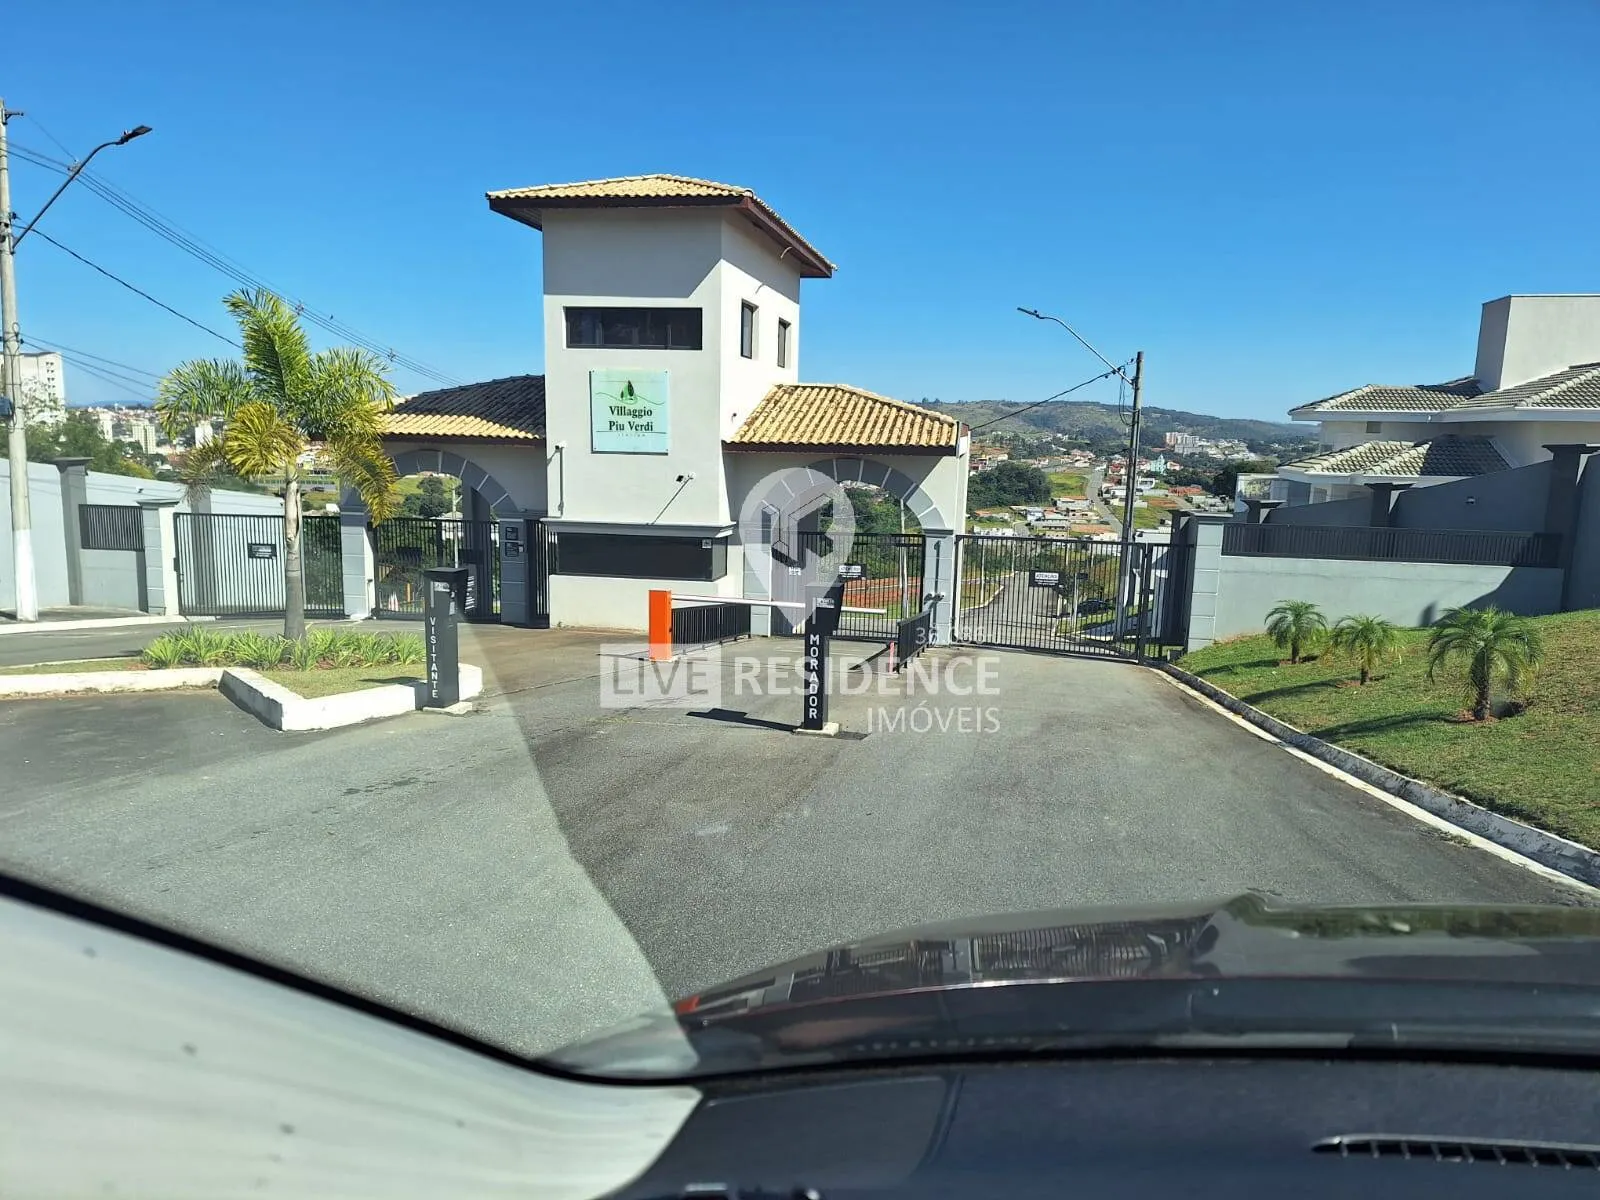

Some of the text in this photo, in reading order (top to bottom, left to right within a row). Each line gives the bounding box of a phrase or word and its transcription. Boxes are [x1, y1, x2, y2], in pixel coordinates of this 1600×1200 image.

[609, 406, 653, 419] Villaggio
[609, 421, 654, 432] Piu Verdi
[429, 616, 438, 698] VISITANTE
[809, 634, 820, 719] MORADOR
